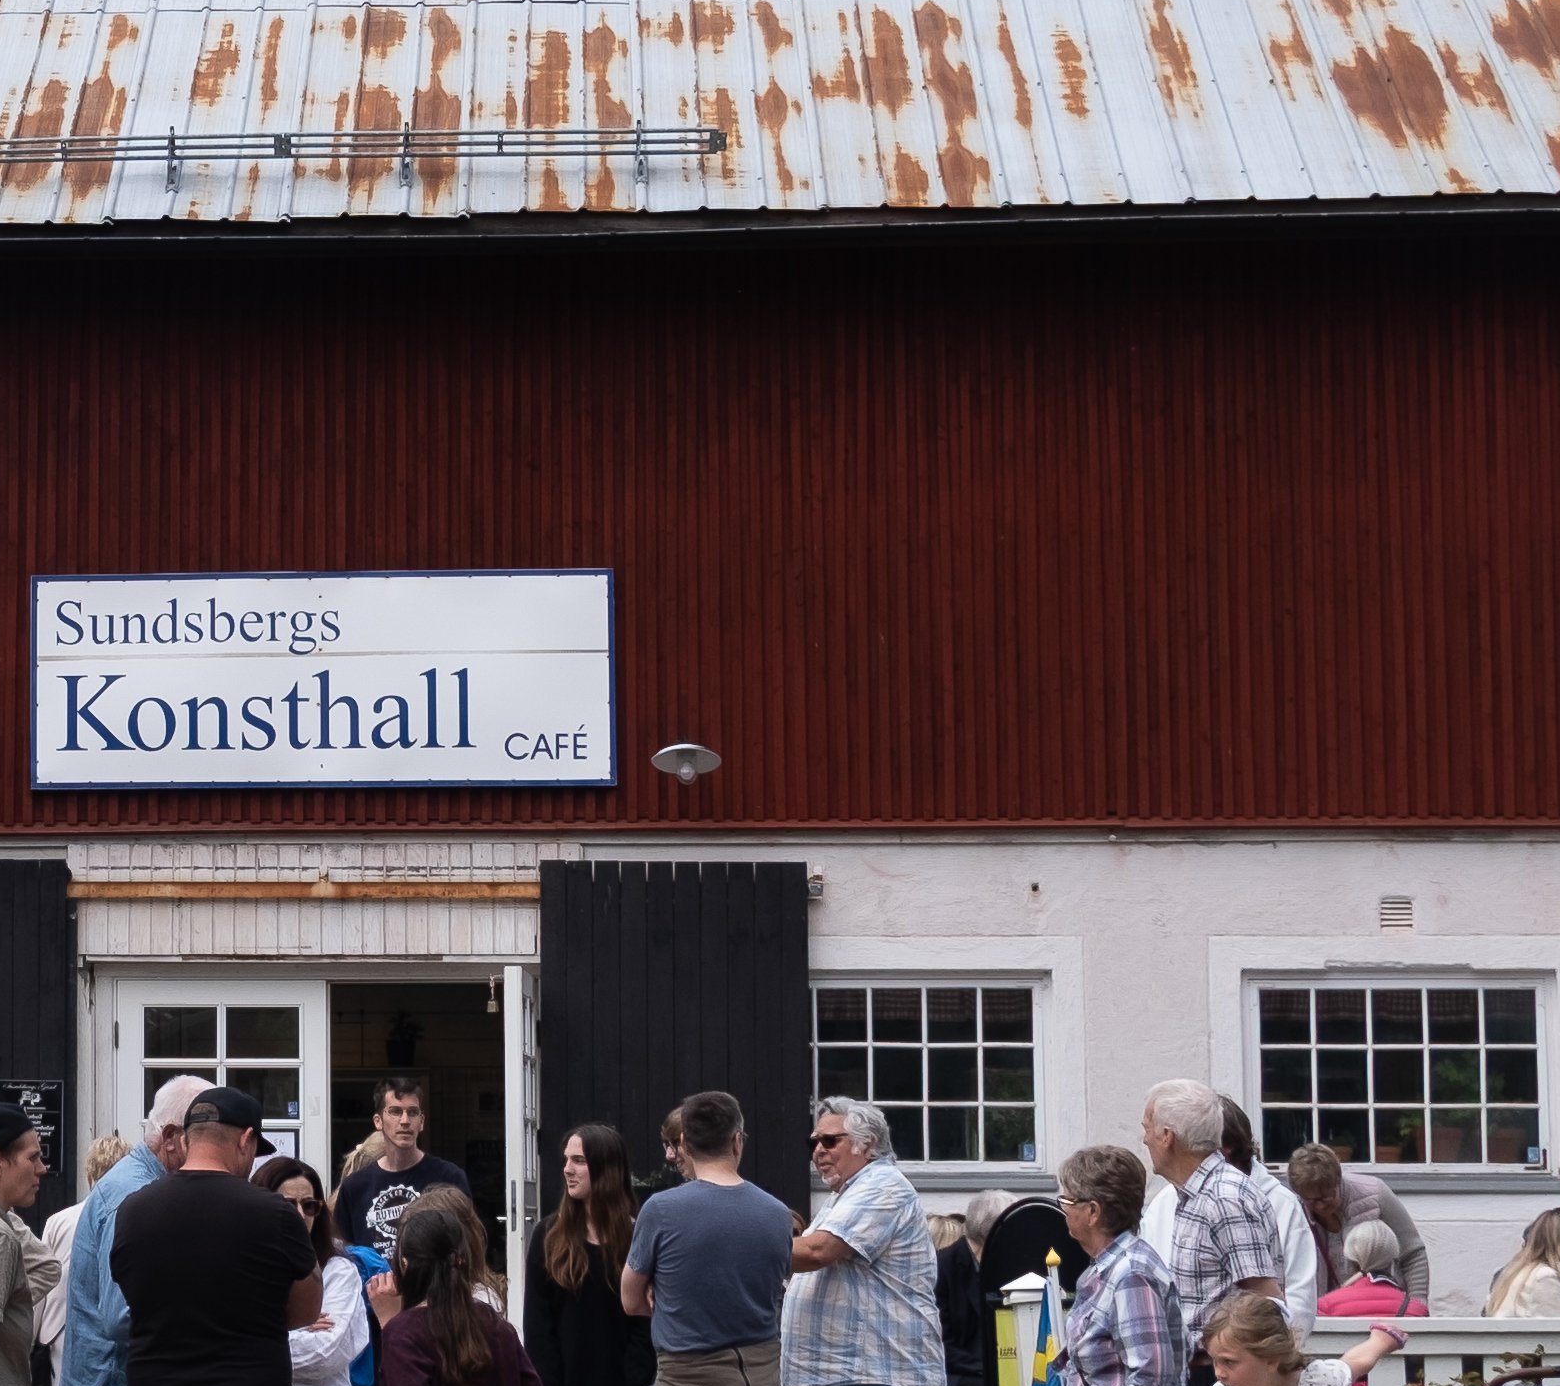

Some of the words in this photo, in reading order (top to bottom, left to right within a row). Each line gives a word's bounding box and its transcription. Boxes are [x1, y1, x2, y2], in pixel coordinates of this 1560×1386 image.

[54, 598, 342, 655] Sundsbergs
[55, 667, 478, 753] Konsthall
[503, 724, 588, 761] CAFÉ
